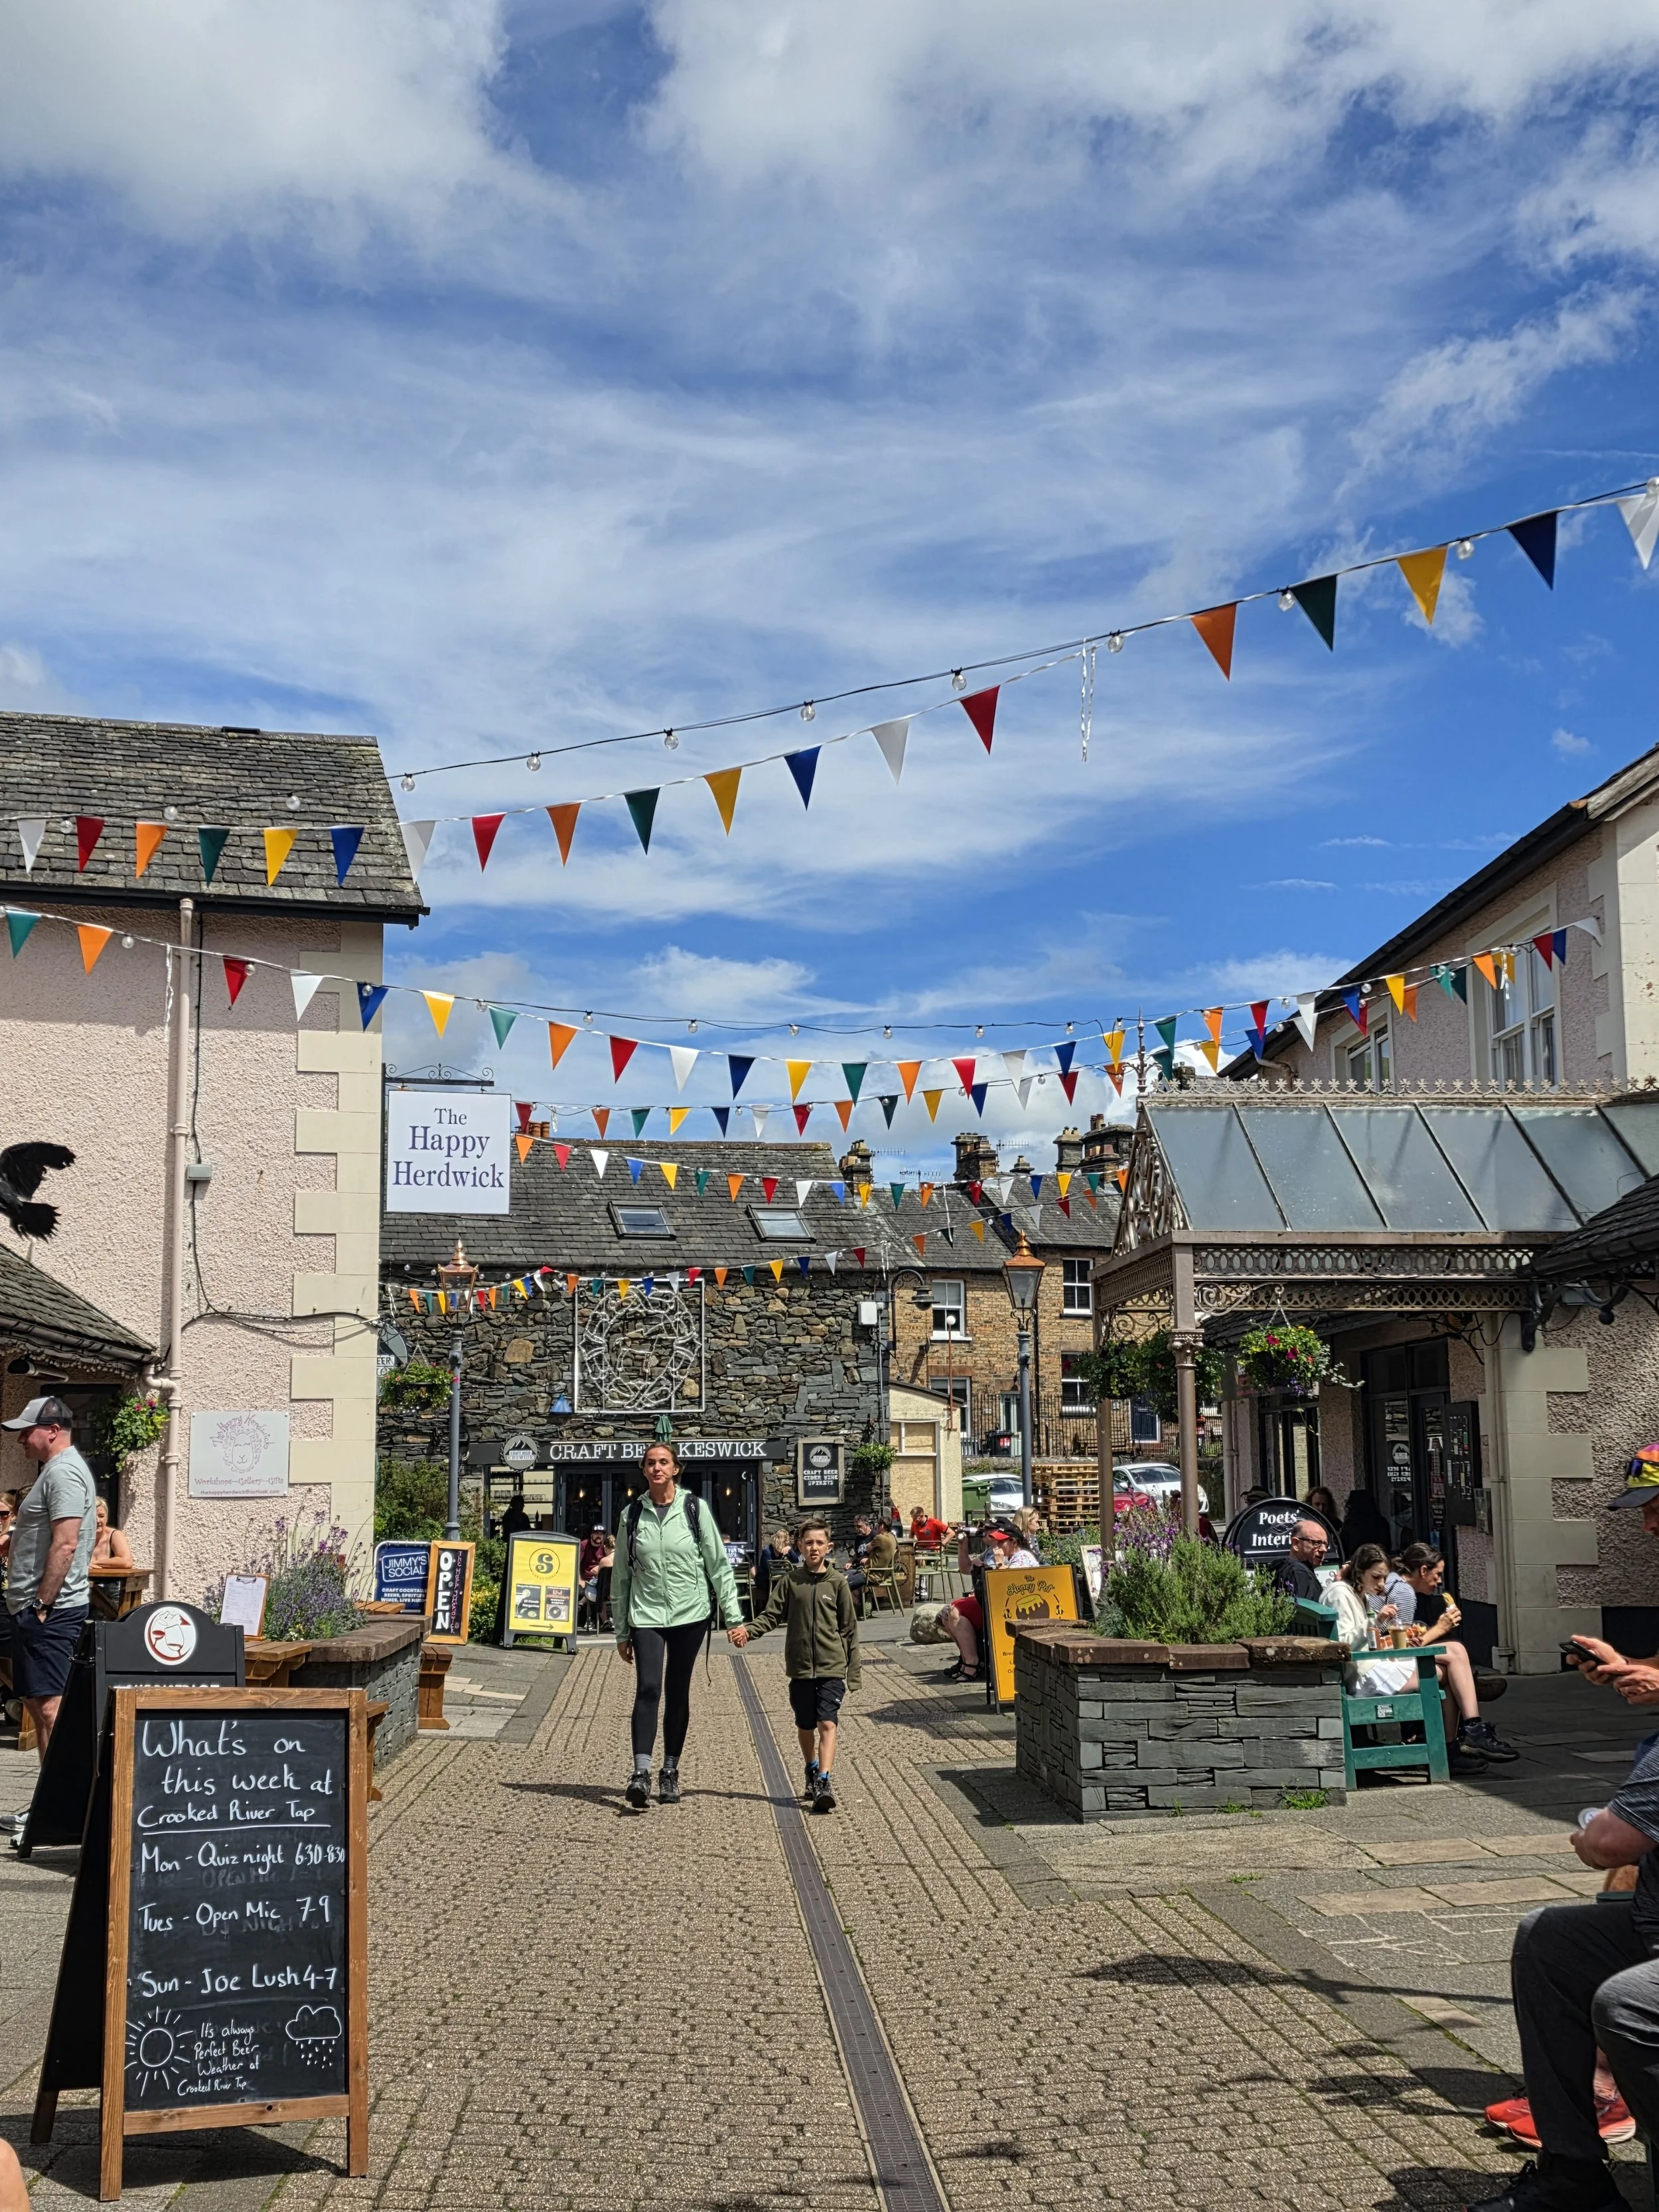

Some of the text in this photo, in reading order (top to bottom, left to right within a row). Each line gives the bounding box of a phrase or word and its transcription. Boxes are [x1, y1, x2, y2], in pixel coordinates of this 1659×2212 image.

[434, 1108, 467, 1125] The
[409, 1126, 490, 1159] Happy
[392, 1161, 505, 1188] Herdwick
[216, 1416, 242, 1432] Happy
[549, 1441, 767, 1459] CRAFT BE KESWICK
[194, 1477, 232, 1486] Workshops
[268, 1477, 283, 1485] Gifts
[1259, 1510, 1300, 1525] Poets'
[1252, 1533, 1292, 1546] Interi
[385, 1556, 427, 1569] JIMMY'S
[388, 1566, 426, 1578] SOCIAL
[536, 1553, 553, 1574] S
[435, 1552, 453, 1629] OPEN
[1007, 1581, 1055, 1595] Honey Pot
[143, 1720, 306, 1757] What's on
[162, 1764, 333, 1795] this week at
[137, 1800, 315, 1827] Crooked River Tap
[141, 1842, 180, 1874] Mon
[198, 1842, 238, 1867] Quiz
[244, 1844, 284, 1875] night
[137, 1903, 173, 1932] Tues
[196, 1903, 238, 1928] Open
[246, 1902, 281, 1920] Mic
[296, 1895, 330, 1923] 7-9
[137, 1971, 179, 1997] Sun
[200, 1968, 240, 1994] Joe
[252, 1963, 300, 1988] Lush
[303, 1964, 337, 1990] 4-7
[201, 2019, 254, 2045] It's always
[194, 2039, 259, 2060] Perfect Beer
[198, 2055, 259, 2075] Weather at
[177, 2077, 247, 2096] Crooked River Tap
